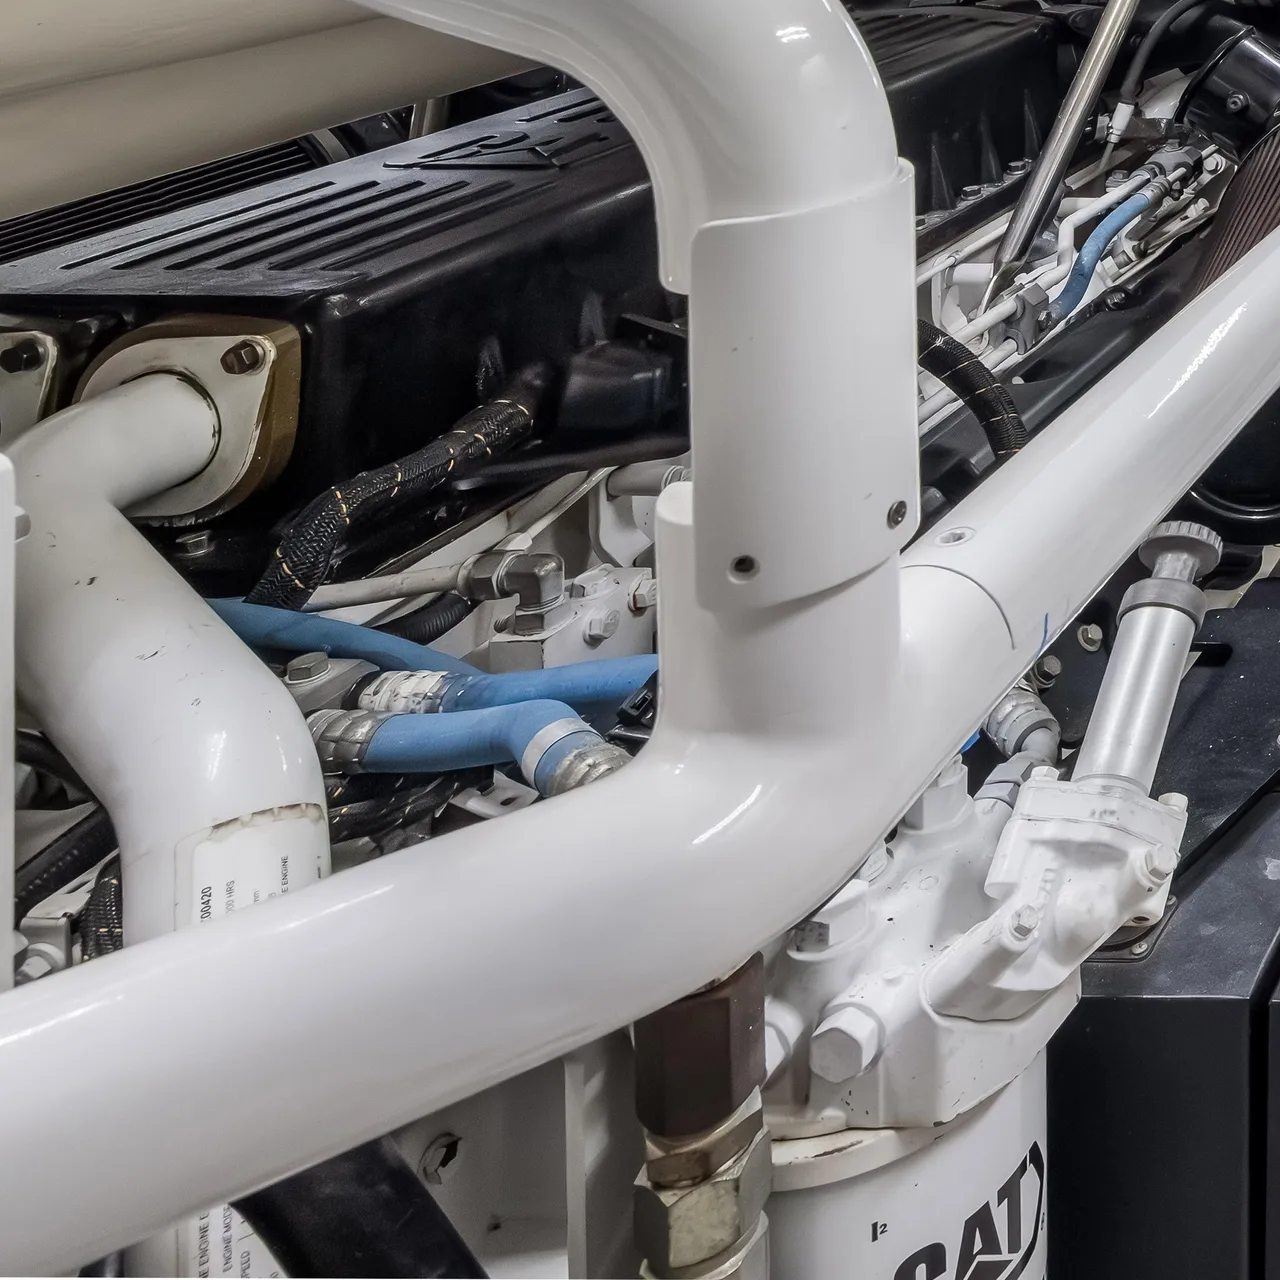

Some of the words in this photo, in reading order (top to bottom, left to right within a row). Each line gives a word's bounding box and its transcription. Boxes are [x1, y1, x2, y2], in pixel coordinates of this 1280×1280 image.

[225, 879, 235, 898] HRS
[281, 855, 289, 886] ENGINE
[200, 886, 212, 923] 00420
[199, 1221, 210, 1267] ENGINE
[222, 1233, 233, 1273] ENGINE
